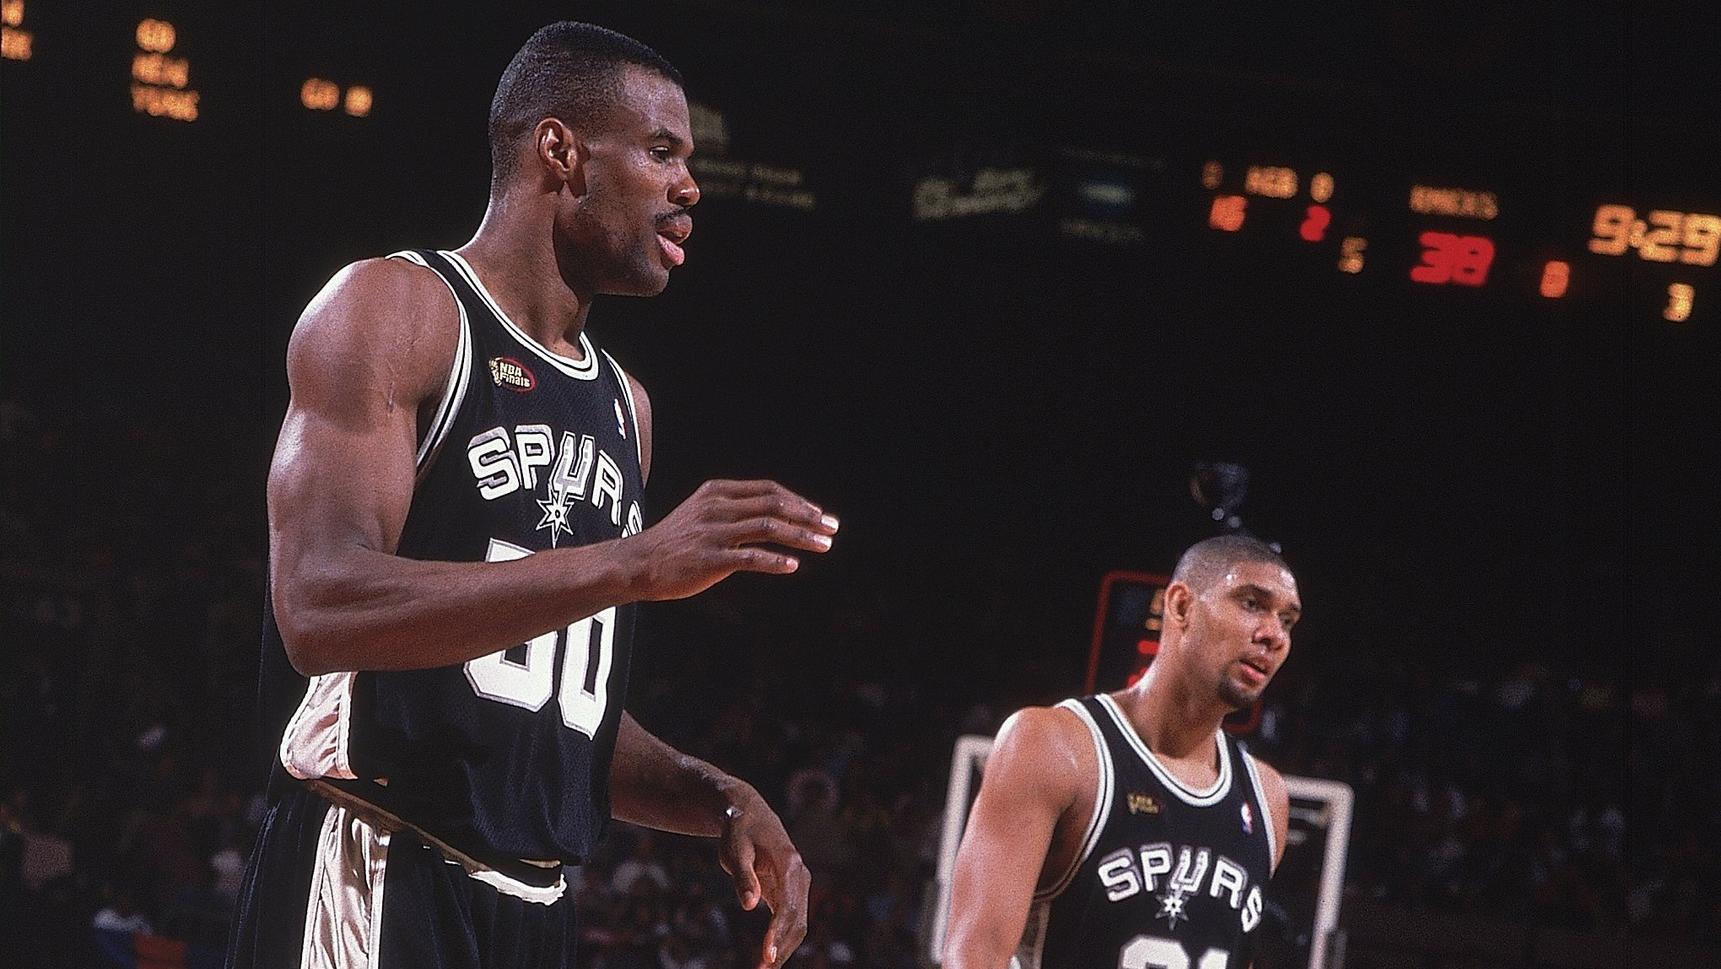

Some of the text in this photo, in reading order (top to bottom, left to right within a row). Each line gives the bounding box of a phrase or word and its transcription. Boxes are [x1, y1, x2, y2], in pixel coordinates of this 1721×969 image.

[1409, 230, 1495, 286] 38
[1588, 203, 1721, 267] 9:29
[499, 362, 523, 377] NBA
[499, 372, 531, 388] Finals
[467, 424, 643, 538] SPURS
[1098, 842, 1263, 933] SPURS
